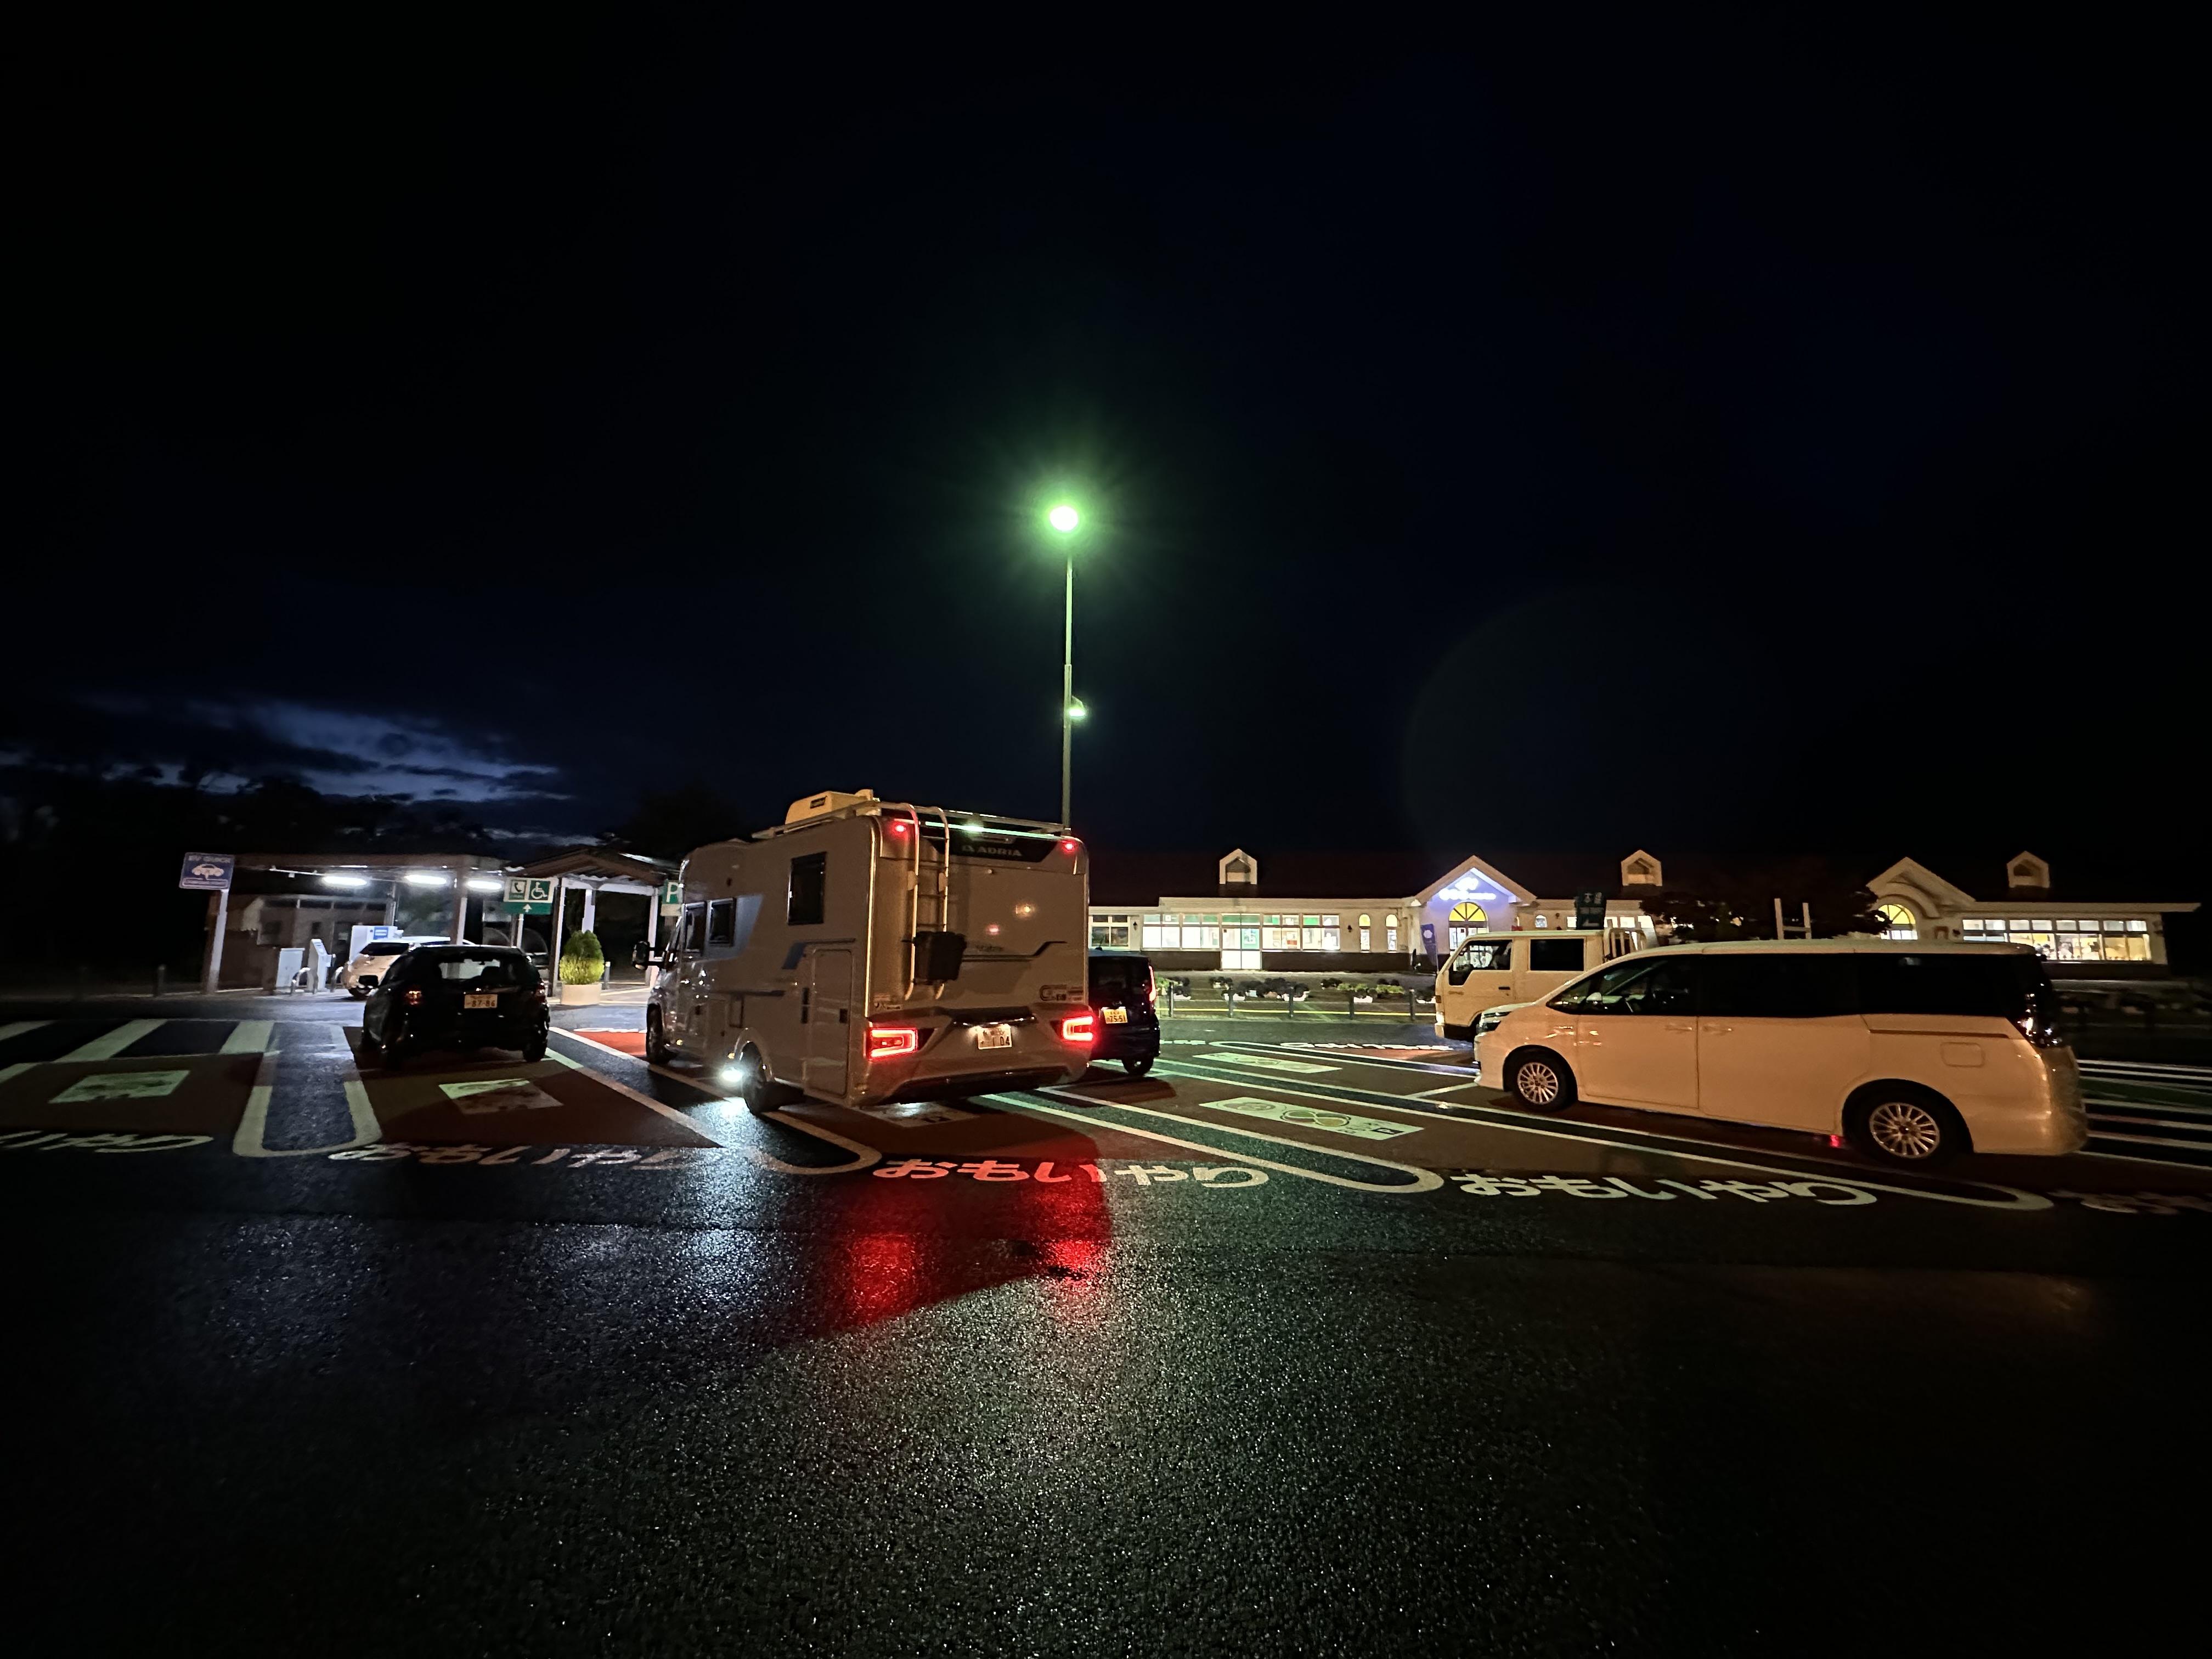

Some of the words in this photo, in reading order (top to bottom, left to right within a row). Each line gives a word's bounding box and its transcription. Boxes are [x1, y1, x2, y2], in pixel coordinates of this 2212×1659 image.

[977, 846, 1023, 856] ADRIA
[666, 882, 679, 903] P
[872, 1159, 1269, 1189] おもいやり
[1451, 1173, 1878, 1206] おもいやり
